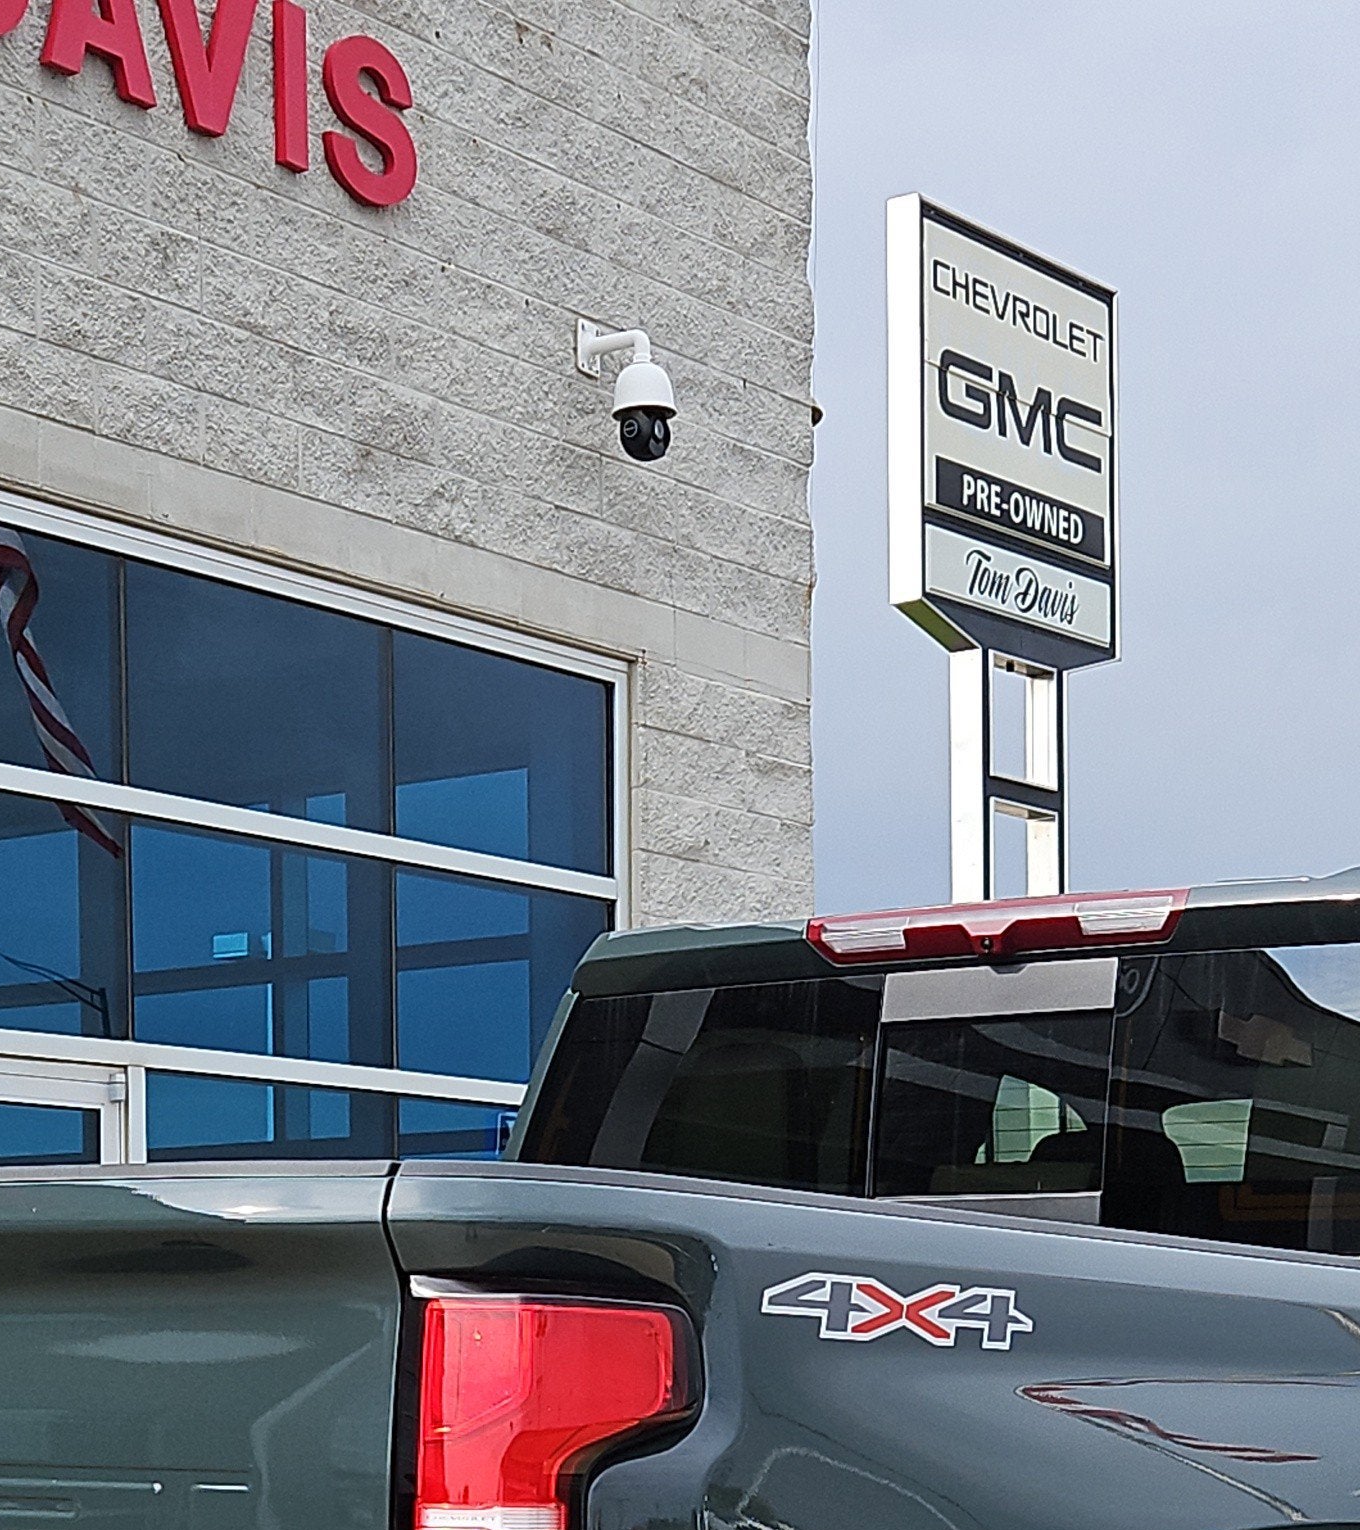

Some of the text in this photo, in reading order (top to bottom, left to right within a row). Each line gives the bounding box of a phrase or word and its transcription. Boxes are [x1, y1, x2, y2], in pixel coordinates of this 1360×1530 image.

[932, 258, 1105, 363] CHEVROLET
[939, 348, 1103, 474] GMC
[961, 473, 1084, 545] PRE-OWNED
[965, 549, 1080, 626] Tom Davis
